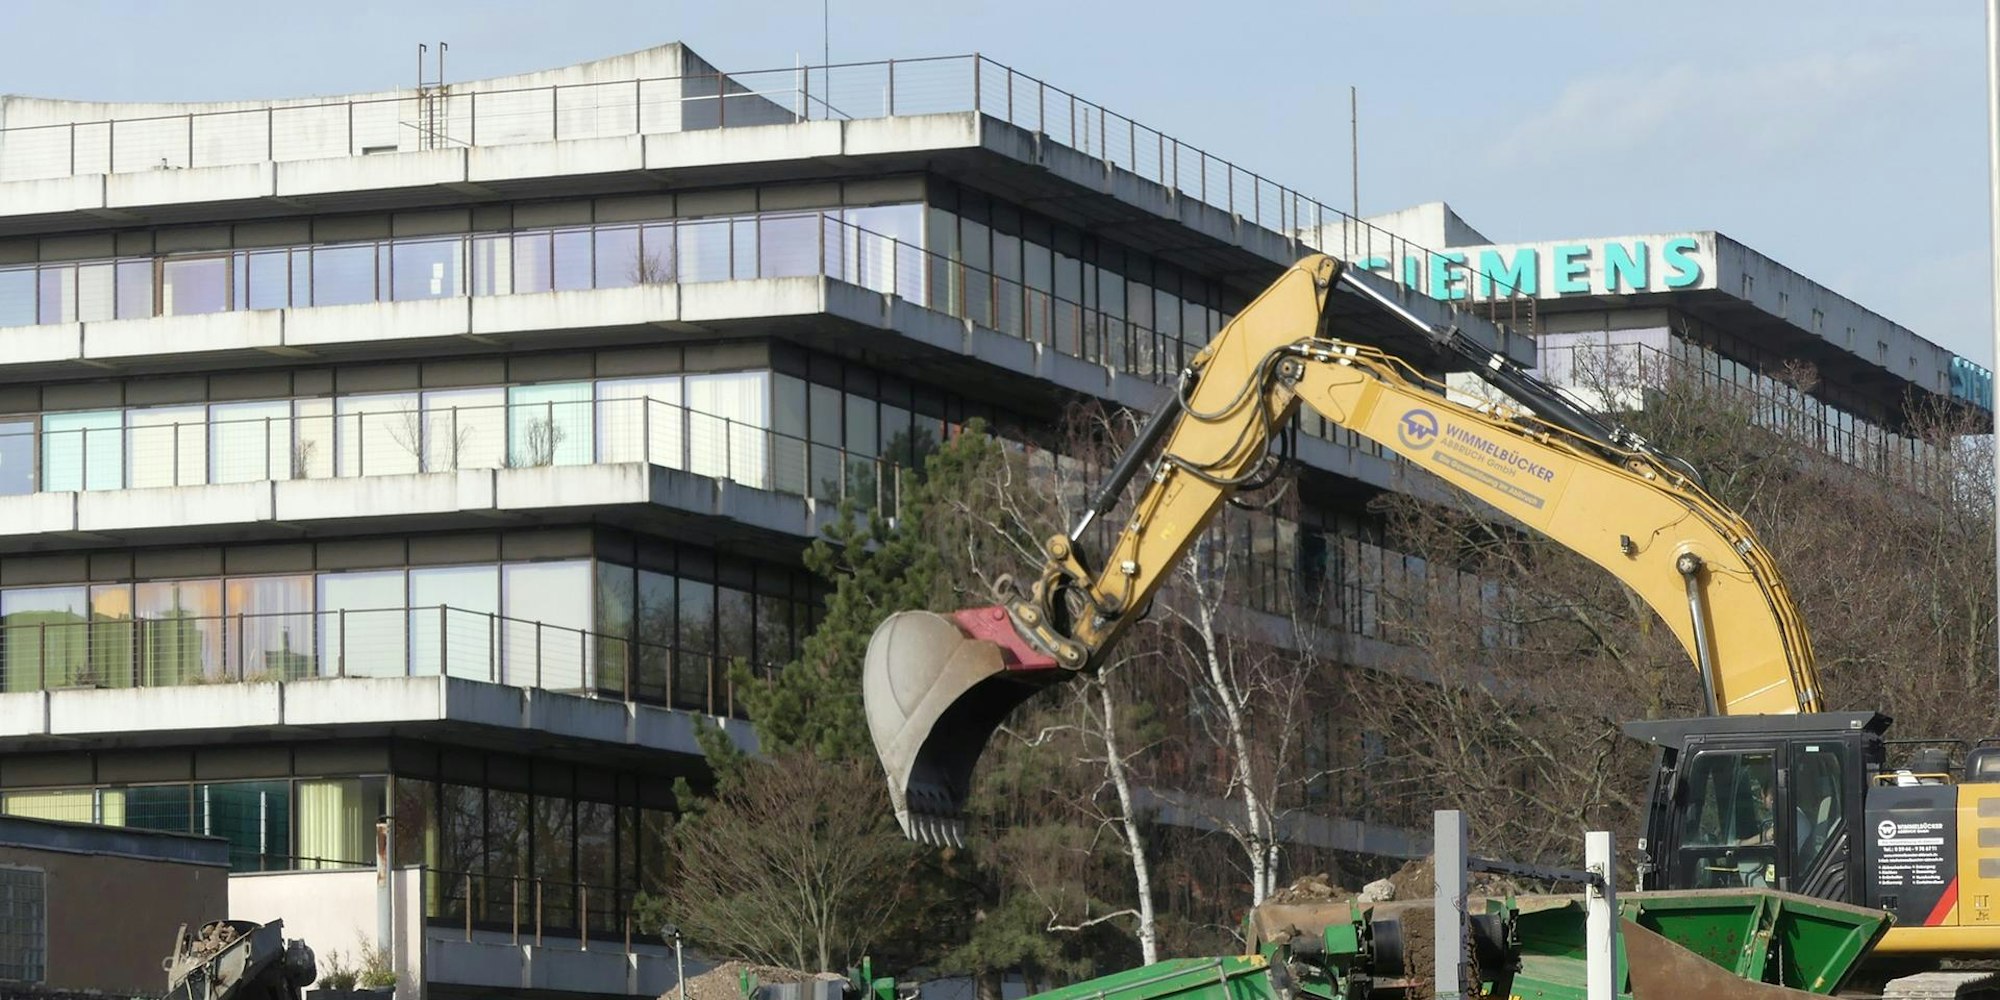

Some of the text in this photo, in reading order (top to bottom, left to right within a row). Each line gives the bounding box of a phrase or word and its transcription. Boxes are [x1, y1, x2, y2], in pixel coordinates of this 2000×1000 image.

[1440, 438, 1517, 478] ABBRUCH GmbH
[1446, 423, 1555, 483] WIMMELBÜCKER
